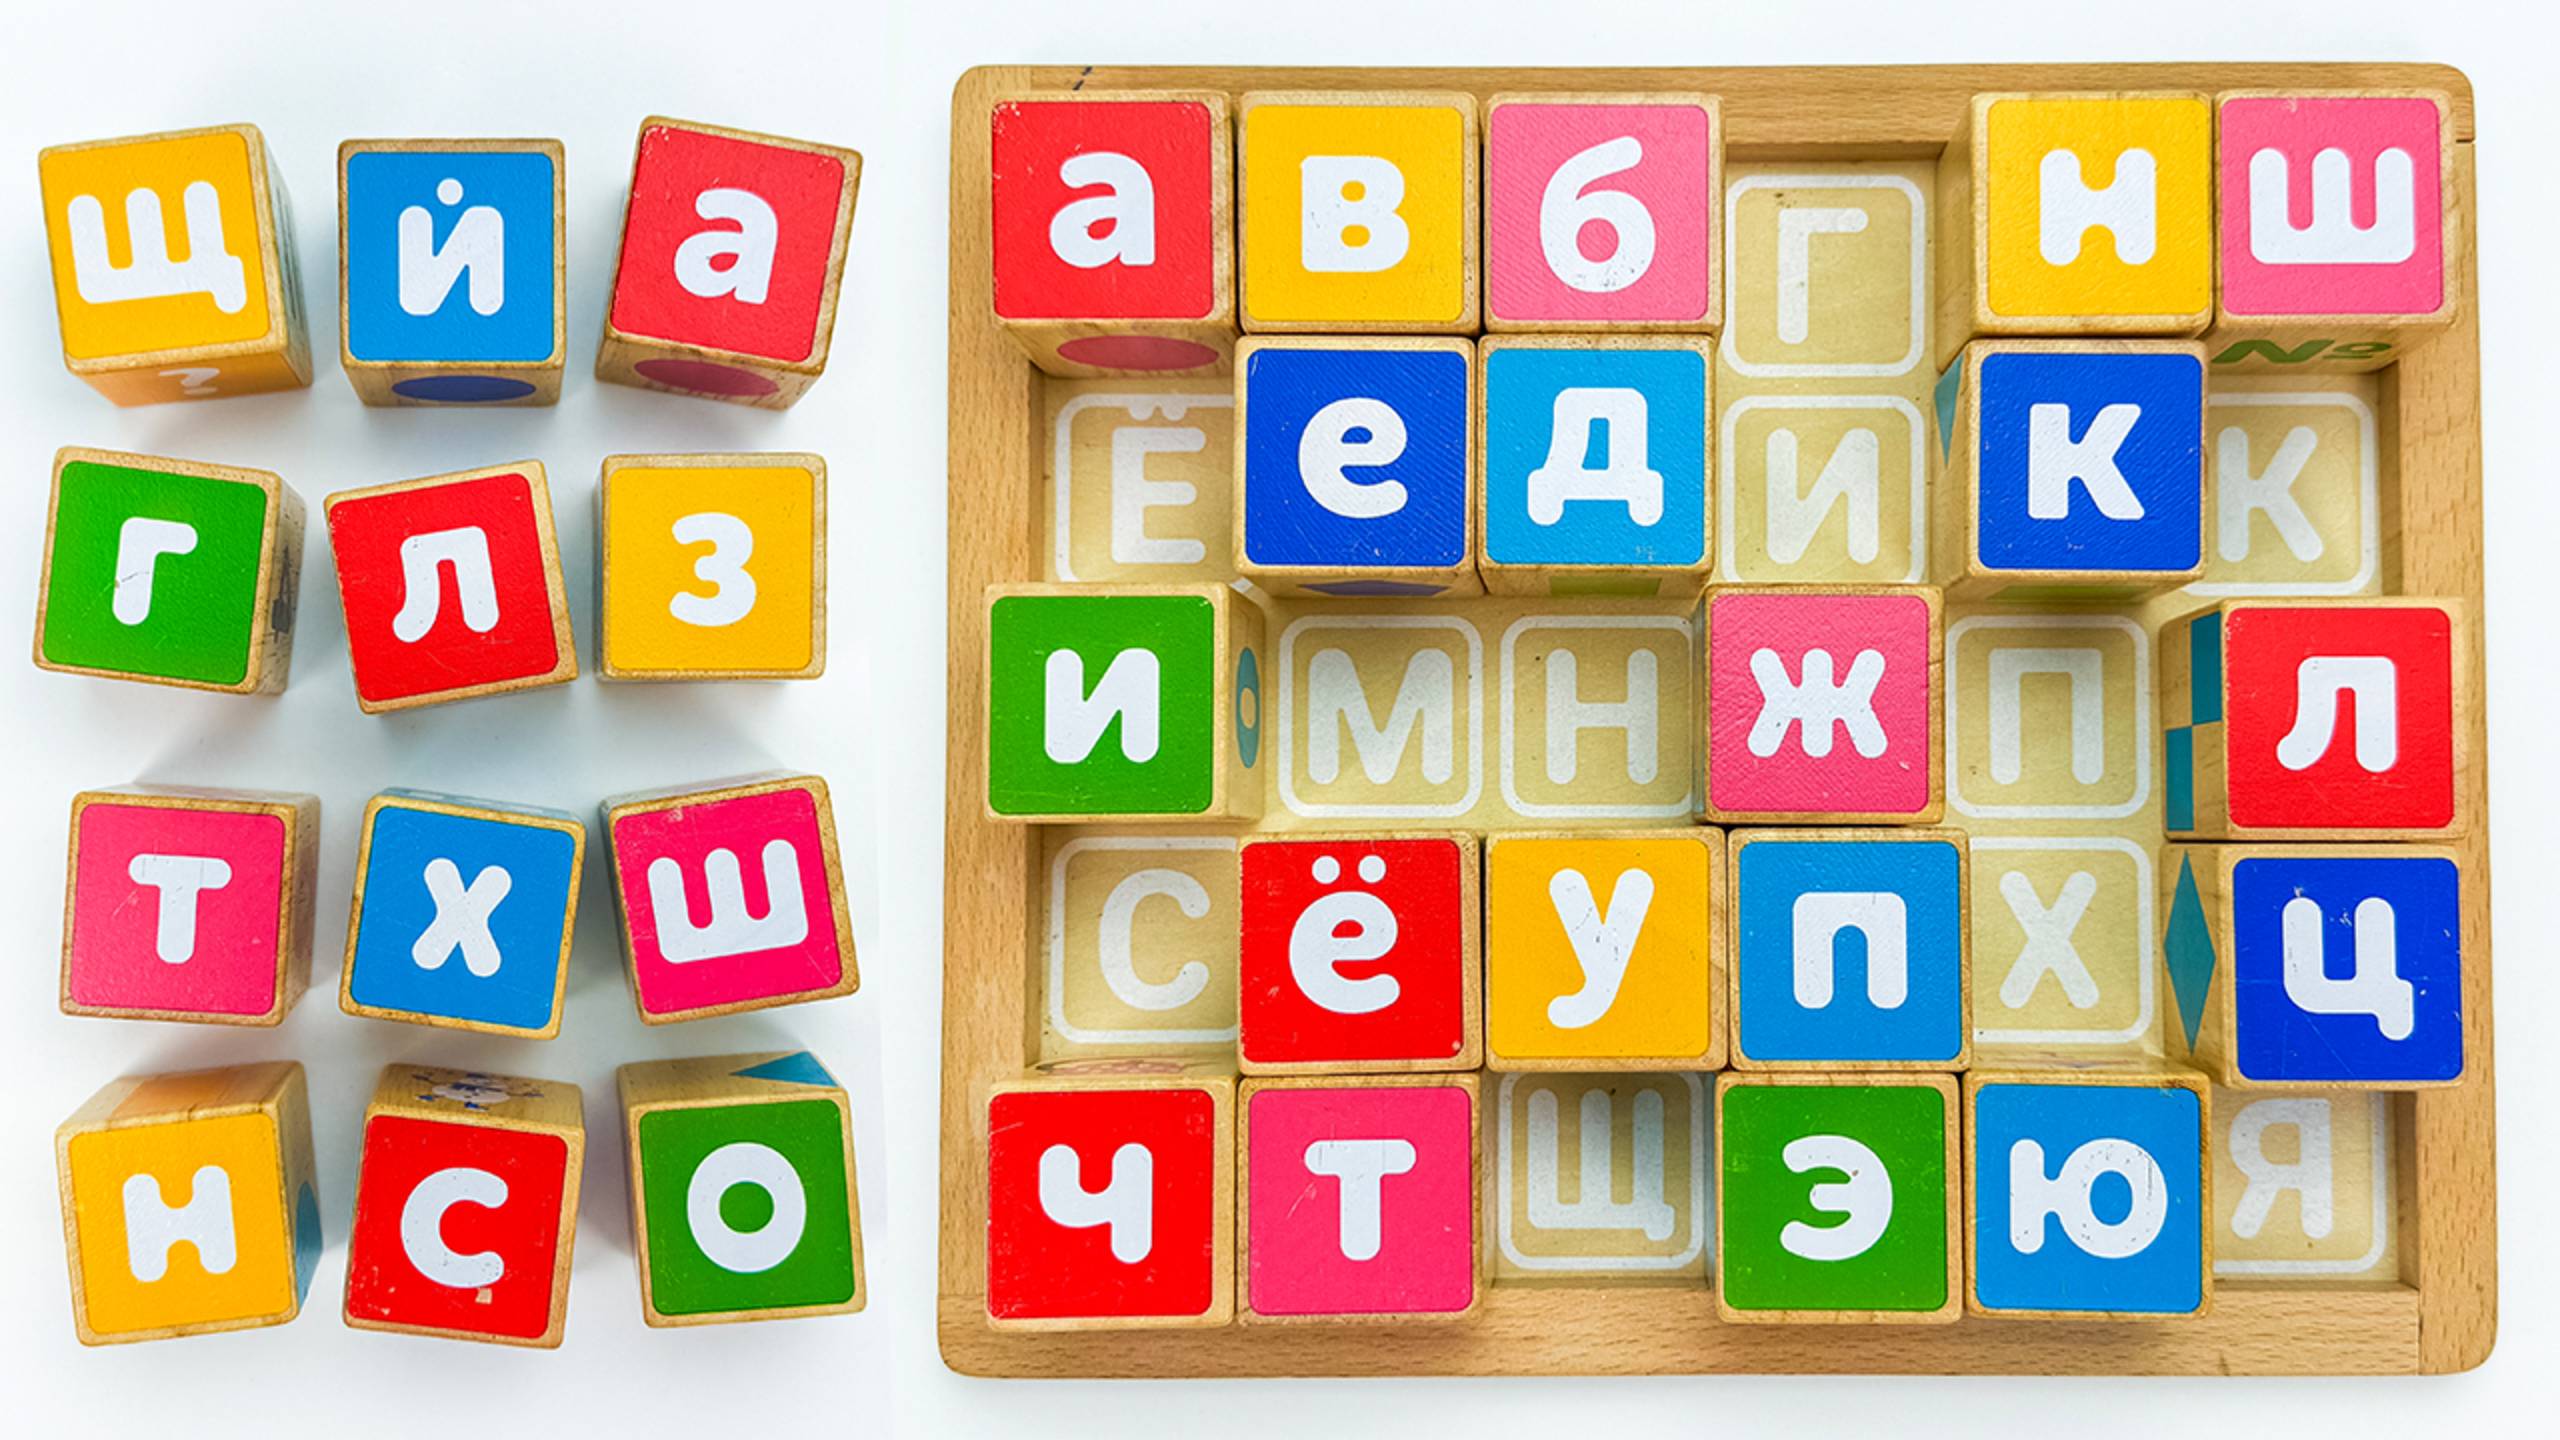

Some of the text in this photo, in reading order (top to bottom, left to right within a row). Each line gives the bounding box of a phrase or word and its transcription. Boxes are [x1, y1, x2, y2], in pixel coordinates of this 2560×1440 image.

[69, 182, 246, 312] щ
[675, 189, 777, 303] а
[1051, 153, 1154, 267] а
[1302, 157, 1408, 271] в
[1540, 137, 1655, 292] б
[2041, 150, 2155, 264] н
[2250, 148, 2415, 264] ш
[1776, 207, 1869, 344] Г
[1111, 396, 1206, 564] Ё
[1299, 399, 1407, 518] е
[1528, 389, 1662, 525] д
[1766, 427, 1879, 564] И
[2029, 404, 2144, 519] к
[2217, 425, 2324, 563] К
[113, 518, 196, 624] г
[394, 527, 498, 642] л
[671, 514, 755, 626] з
[1046, 649, 1159, 763] и
[1307, 647, 1454, 784] М
[1545, 649, 1659, 784] Н
[1748, 649, 1887, 758] ж
[1988, 647, 2105, 784] П
[2278, 657, 2396, 772] л
[129, 855, 231, 963] т
[413, 859, 511, 976] х
[648, 840, 808, 962] ш
[1098, 868, 1210, 1011] С
[1290, 856, 1399, 1013] ё
[1549, 870, 1654, 1027] у
[1794, 893, 1906, 1008] п
[1998, 870, 2100, 1010] Х
[2283, 898, 2412, 1040] ц
[124, 1167, 236, 1281] н
[688, 1143, 806, 1272] о
[1040, 1144, 1152, 1262] ч
[1305, 1140, 1415, 1260] т
[1526, 1088, 1675, 1242] Щ
[1781, 1136, 1892, 1260] э
[2011, 1140, 2166, 1257] ю
[2228, 1097, 2334, 1239] Я
[402, 1168, 507, 1287] с
